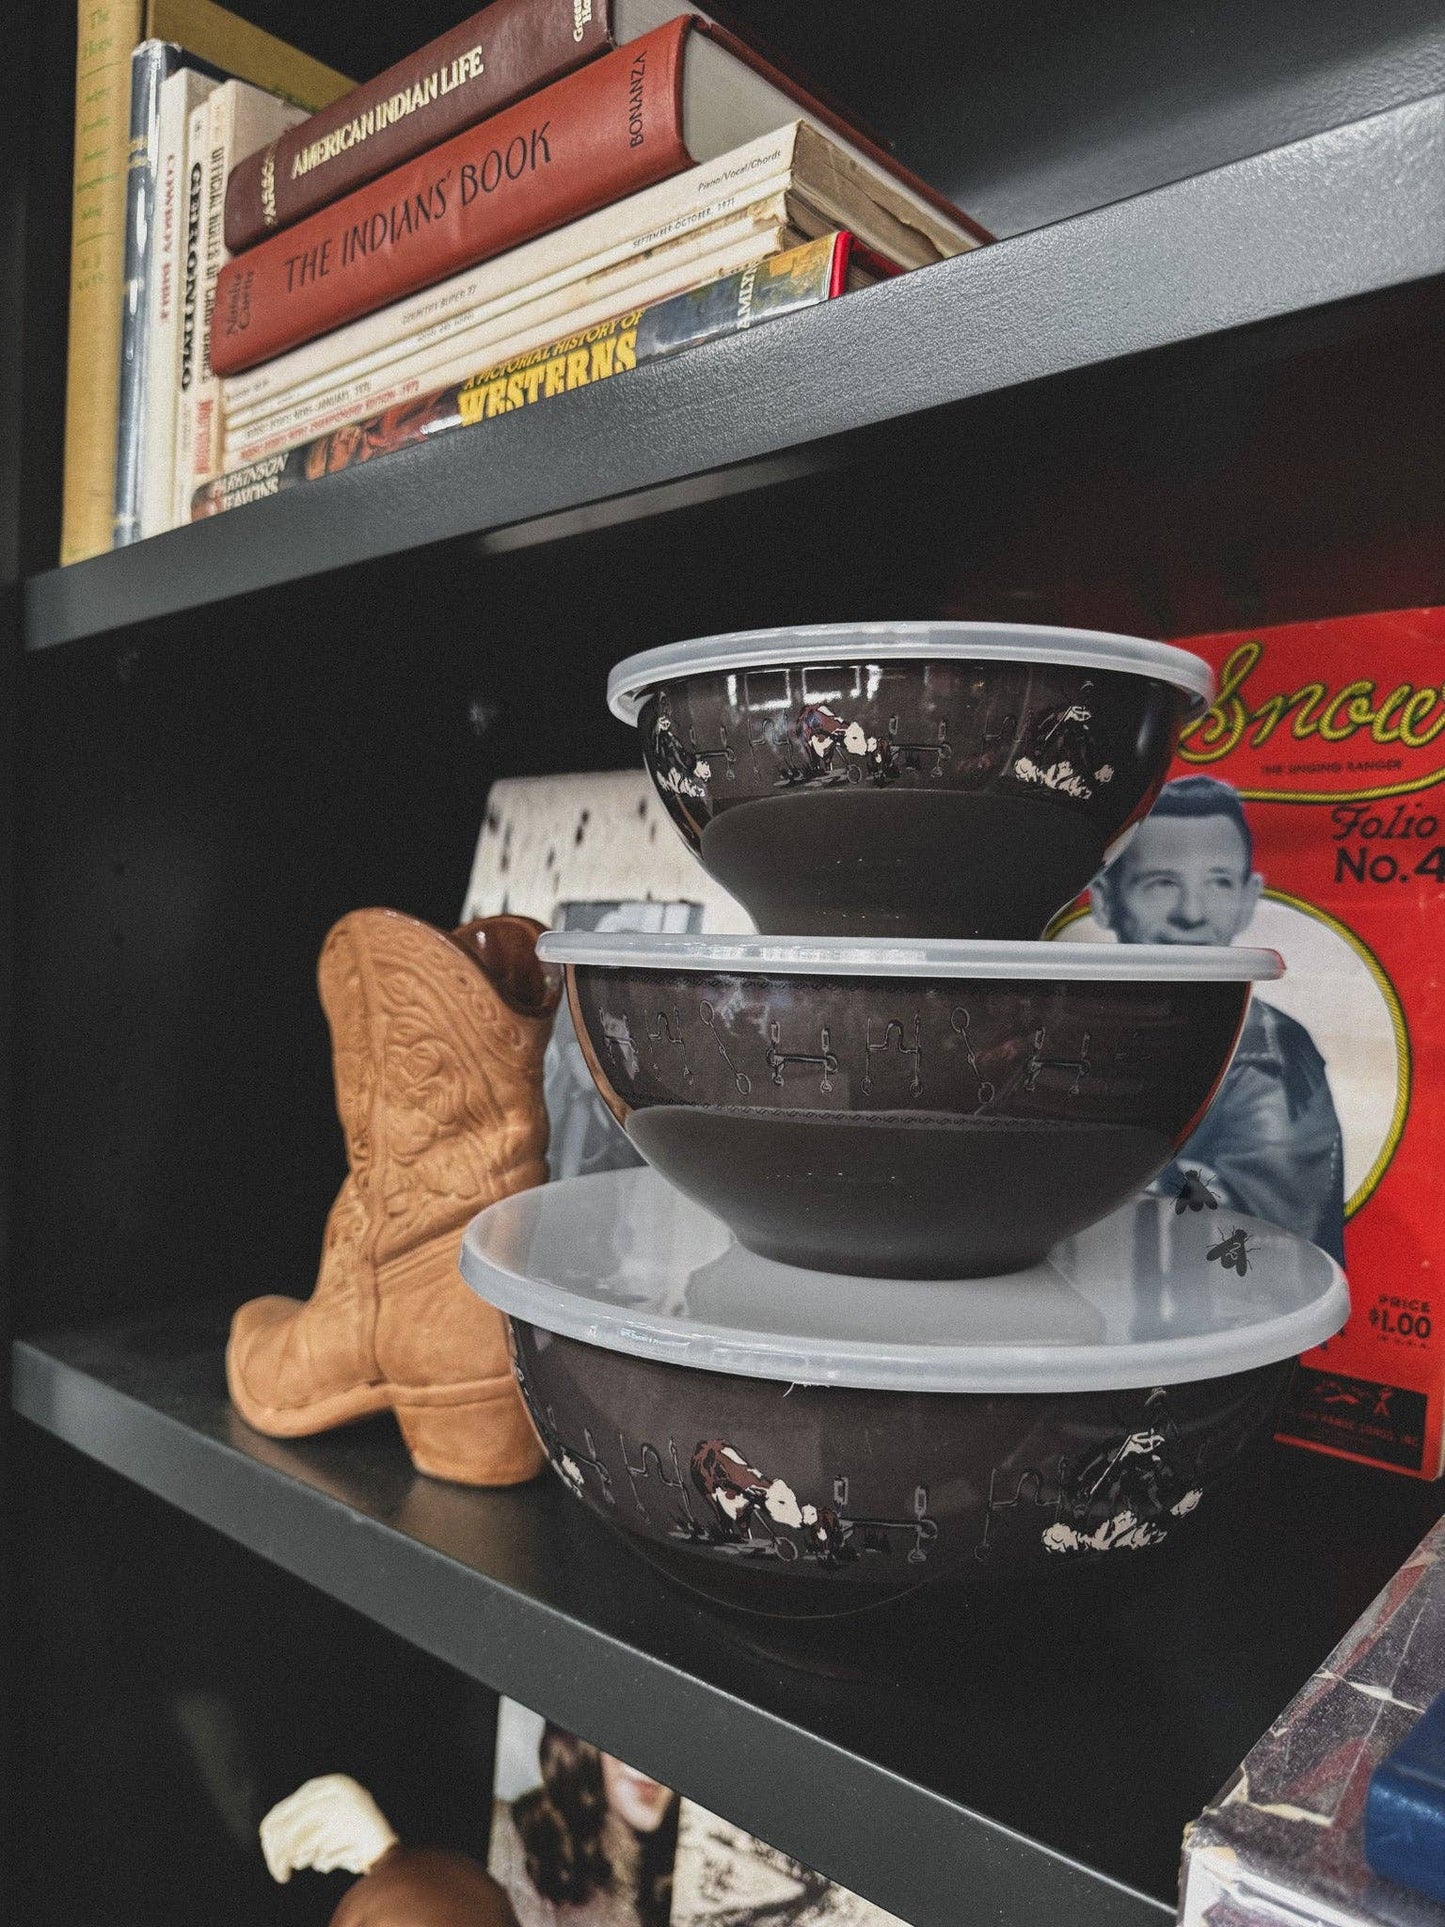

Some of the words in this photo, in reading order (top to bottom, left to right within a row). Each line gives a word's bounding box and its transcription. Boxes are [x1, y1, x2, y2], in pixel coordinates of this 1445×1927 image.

[291, 108, 376, 180] AMERICAN
[376, 72, 439, 133] INDIAN
[440, 44, 485, 97] LIFE
[629, 52, 647, 148] BONANZA
[284, 239, 332, 293] THE
[341, 169, 452, 268] INDIANS'
[460, 120, 551, 207] BOOK
[181, 162, 202, 392] GERONIMO
[457, 329, 639, 428] WESTERNS
[476, 346, 550, 387] PICTORIAL
[553, 320, 620, 361] HISTORY
[619, 310, 646, 334] OF
[1176, 640, 1445, 764] Snow
[1330, 802, 1438, 842] Folio
[1368, 1306, 1432, 1339] $1.00
[1378, 1293, 1431, 1313] PRICE
